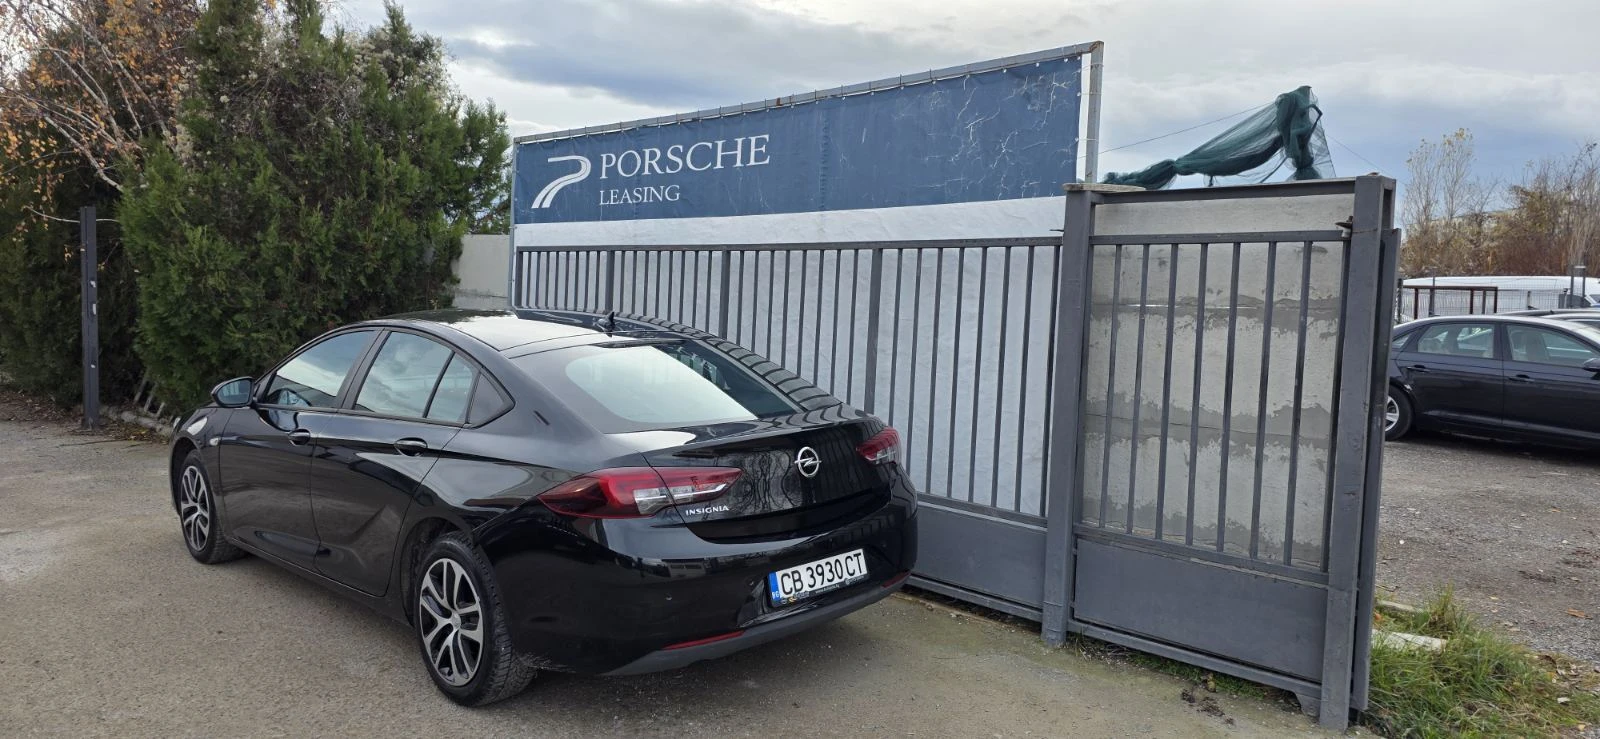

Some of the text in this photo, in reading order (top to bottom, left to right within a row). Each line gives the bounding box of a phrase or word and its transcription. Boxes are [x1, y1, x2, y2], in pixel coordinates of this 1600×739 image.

[600, 134, 771, 180] PORSCHE
[599, 184, 681, 206] LEASING
[685, 505, 730, 516] INSIGNIA
[780, 569, 804, 595] CB
